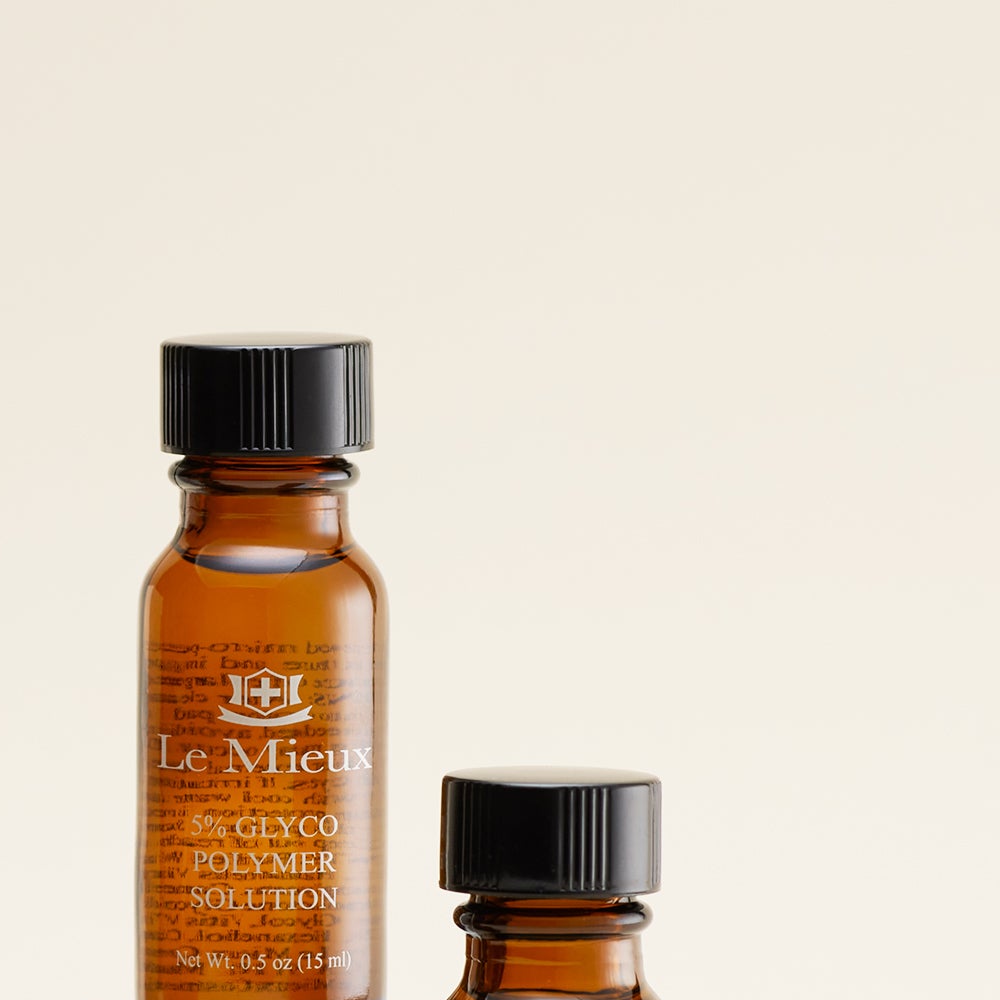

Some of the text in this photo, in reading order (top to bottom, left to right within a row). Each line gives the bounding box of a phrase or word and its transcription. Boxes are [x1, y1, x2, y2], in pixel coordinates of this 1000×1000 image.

[158, 734, 372, 775] Le Mieux
[191, 814, 338, 838] 5% GLYCO
[193, 850, 336, 875] POLYMER
[190, 886, 338, 910] SOLUTION
[176, 950, 201, 967] Net
[206, 952, 234, 970] Wt.
[240, 953, 266, 971] 0.5
[272, 958, 292, 970] oz
[297, 953, 322, 973] (15
[328, 950, 351, 970] ml)
